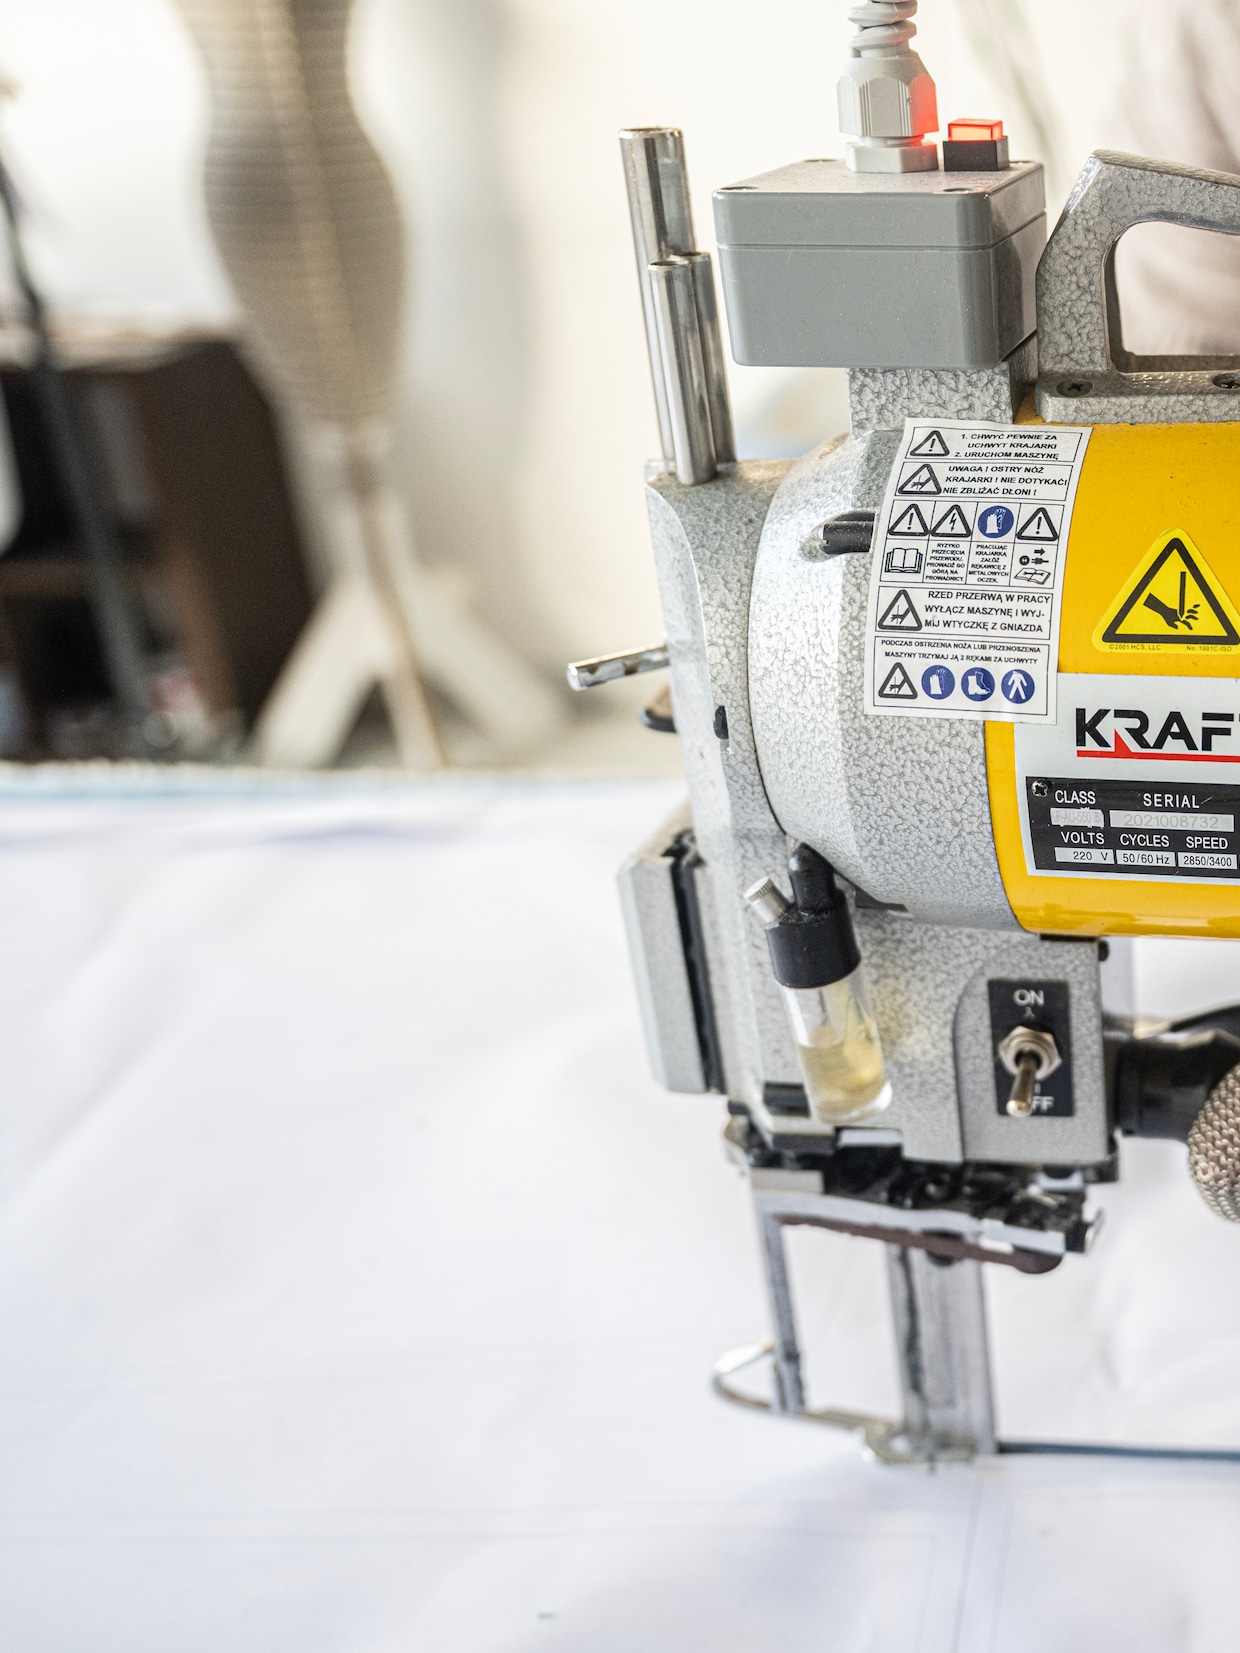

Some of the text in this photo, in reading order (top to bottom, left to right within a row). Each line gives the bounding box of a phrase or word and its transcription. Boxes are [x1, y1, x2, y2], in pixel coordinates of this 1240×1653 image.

[960, 486, 999, 494] ZBLIŻAĆ
[928, 591, 953, 599] RZED
[956, 592, 1003, 603] PRZERWĄ
[1017, 595, 1050, 604] PRACY
[925, 605, 964, 615] WYŁĄCZ
[967, 607, 1013, 618] MASZYNĘ
[1021, 609, 1045, 618] WYJ-
[943, 621, 988, 631] WTYCZKĘ
[1000, 623, 1043, 632] GNIAZDA
[1055, 790, 1096, 804] CLASS
[1143, 793, 1200, 808] SERIAL
[1124, 814, 1219, 829] 2021008732
[1061, 832, 1104, 844] VOLTS
[1120, 834, 1169, 847] CYCLES
[1186, 836, 1228, 849] SPEED
[1073, 851, 1108, 860] 220 V
[1122, 853, 1170, 864] 50/60 Hz
[1183, 856, 1232, 867] 2850/3400
[1013, 988, 1045, 1006] ON
